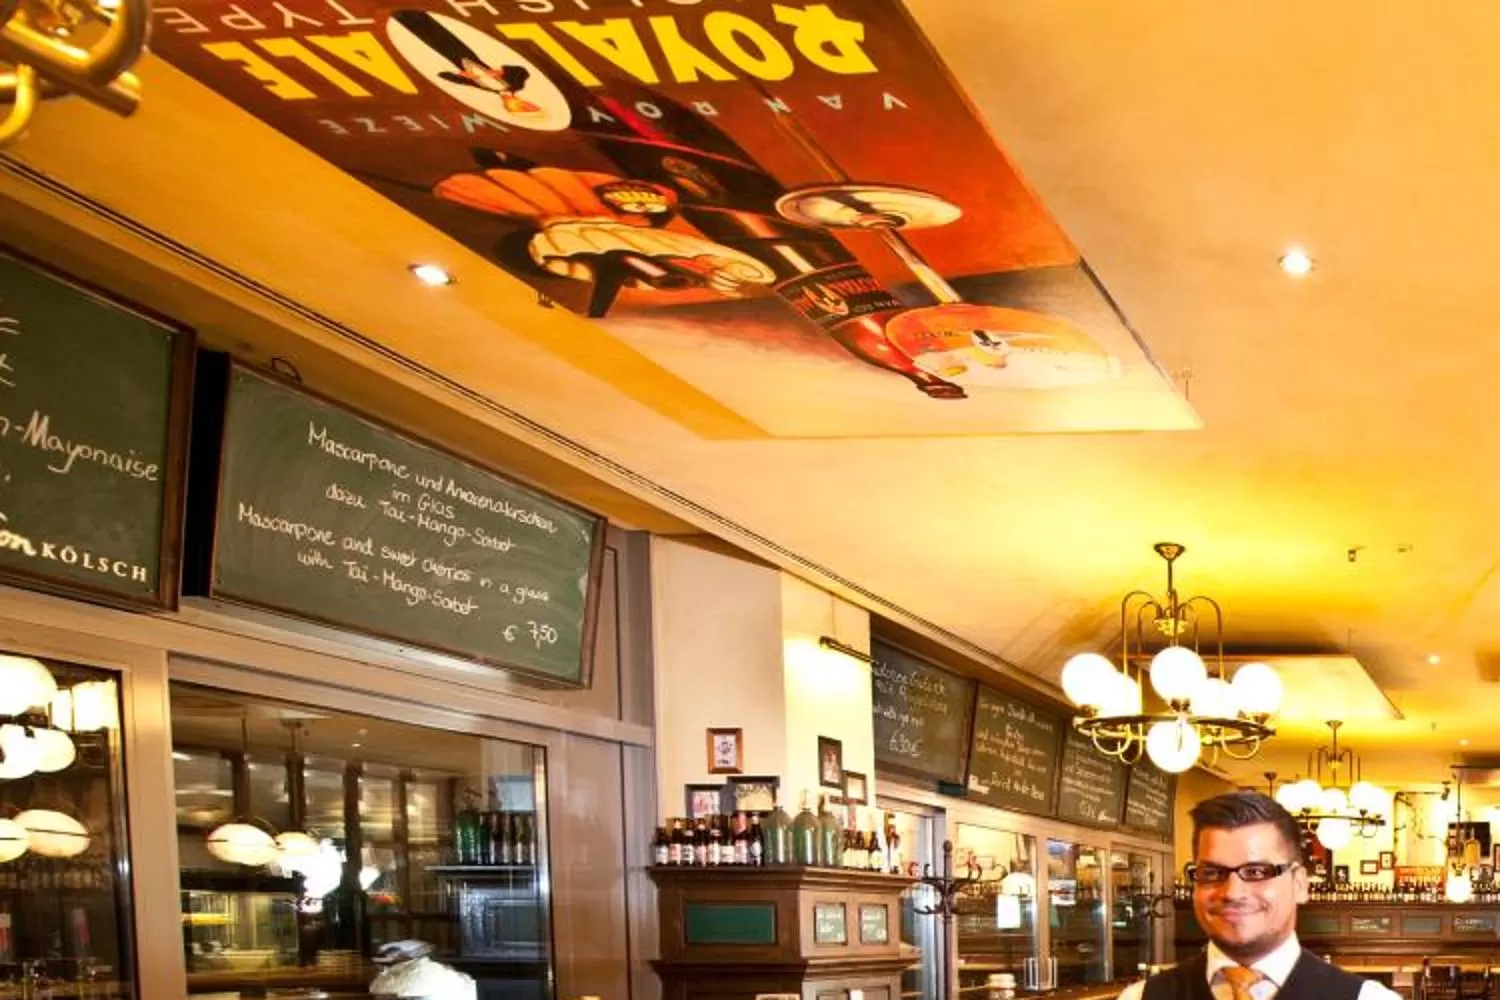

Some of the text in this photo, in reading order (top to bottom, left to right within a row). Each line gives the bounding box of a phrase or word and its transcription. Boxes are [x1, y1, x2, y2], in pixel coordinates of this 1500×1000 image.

[152, 0, 376, 34] TYPE
[201, 3, 879, 101] ROYAL ALE
[318, 91, 907, 136] VAN ROY WIEZE
[306, 420, 411, 479] Mascarpone
[415, 473, 443, 493] und
[325, 482, 367, 509] dazu
[417, 493, 456, 520] Glas
[40, 541, 147, 582] KÖLSCH
[238, 501, 336, 545] Mascarpone
[342, 535, 374, 557] and
[499, 583, 511, 595] a
[502, 619, 558, 650] € 7,50
